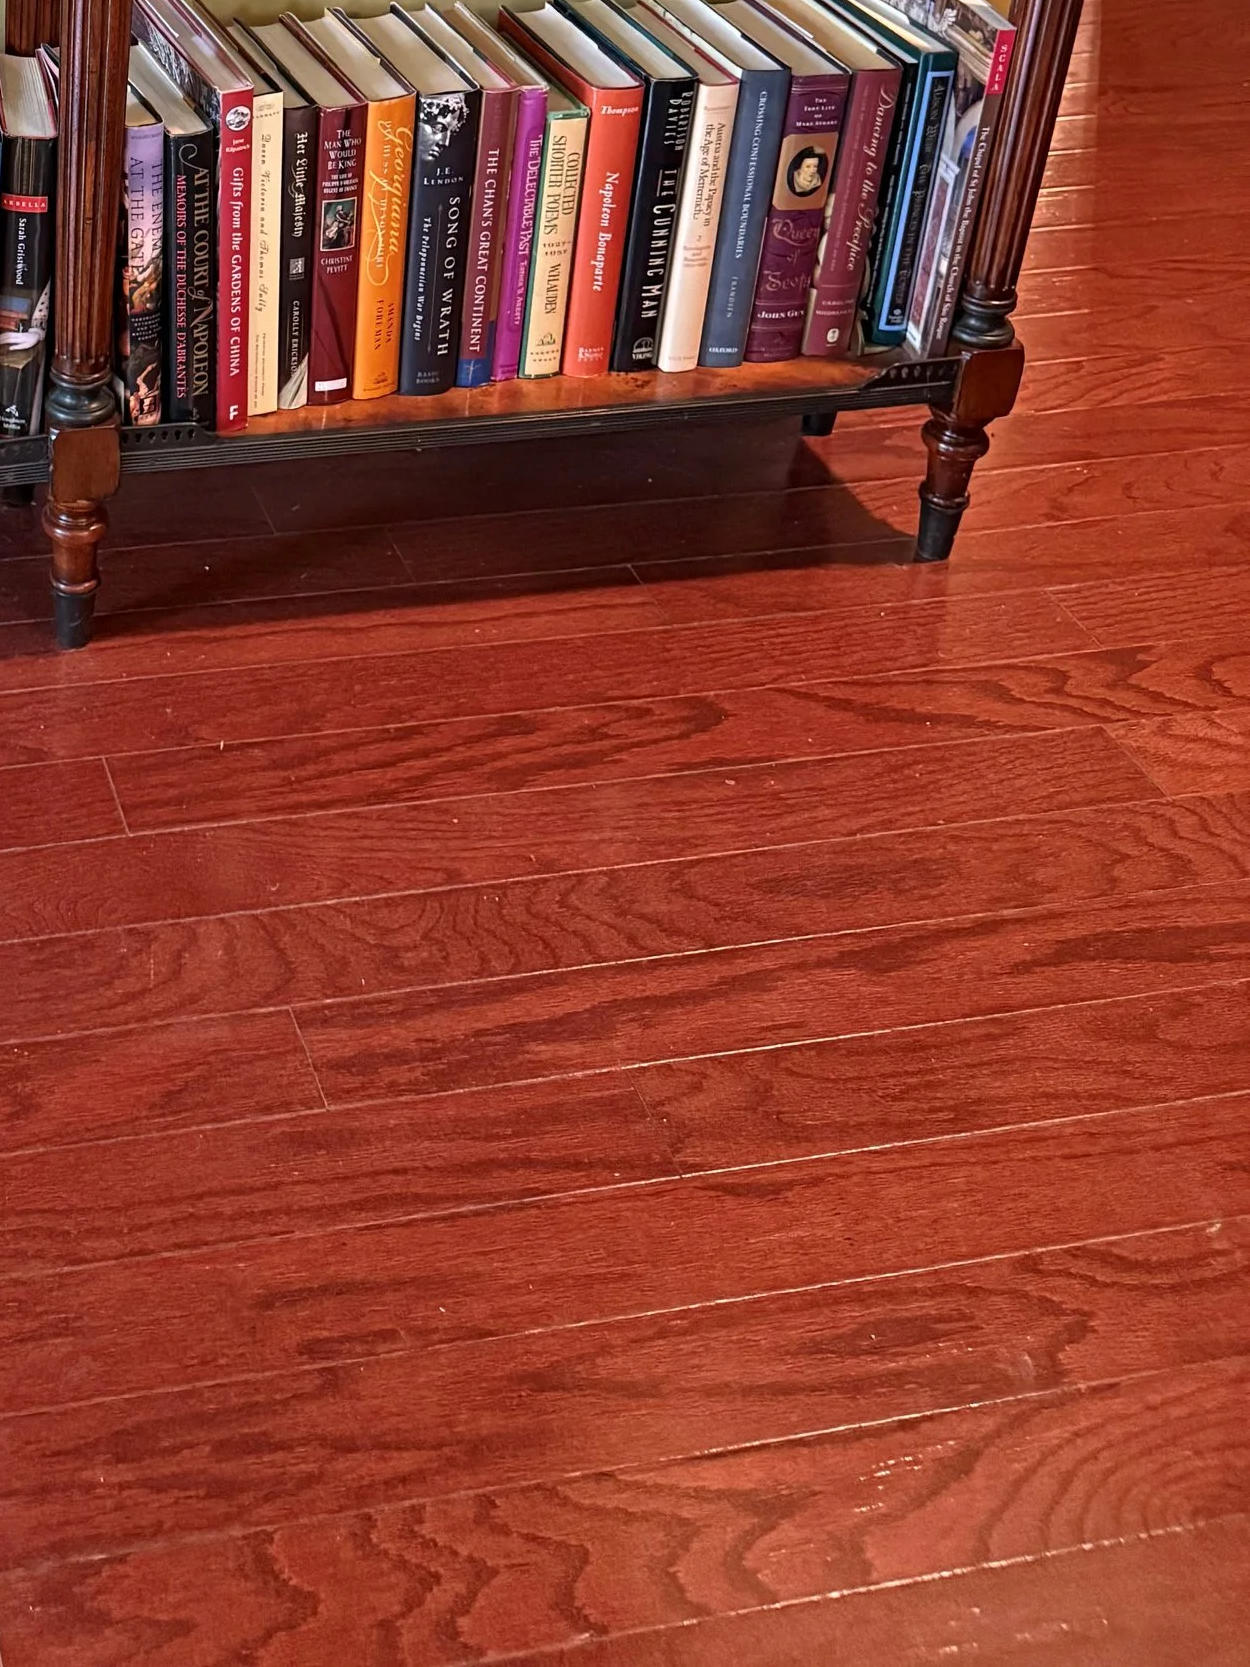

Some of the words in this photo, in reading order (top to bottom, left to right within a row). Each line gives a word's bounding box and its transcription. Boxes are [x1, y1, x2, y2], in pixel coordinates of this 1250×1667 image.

[991, 44, 1008, 91] SCALA
[601, 106, 639, 117] Thompson
[663, 99, 682, 145] DAVIES
[674, 92, 694, 151] ROBERTSON
[754, 91, 768, 135] CROSSING
[863, 86, 895, 157] Dancing
[296, 132, 308, 155] Her
[324, 141, 342, 150] MAN
[343, 139, 362, 147] WHO
[336, 130, 351, 139] THE
[529, 134, 543, 157] THE
[705, 123, 714, 137] the
[715, 122, 726, 155] Austria
[329, 150, 357, 160] WOULD
[487, 148, 500, 174] THE
[548, 135, 567, 188] SHORTER
[700, 138, 711, 155] Age
[700, 155, 708, 167] of
[130, 157, 144, 179] AT
[152, 158, 163, 196] THE
[179, 144, 209, 185] AT
[291, 158, 308, 191] Little
[328, 162, 337, 170] BE
[338, 159, 357, 170] KING
[711, 170, 720, 184] the
[713, 155, 721, 170] and
[745, 137, 761, 200] CONFESSIONAL
[865, 162, 878, 175] to
[231, 167, 244, 197] Gifts
[386, 124, 413, 253] Georgiana
[424, 176, 464, 185] LENDON
[521, 157, 541, 228] DELECTABLE
[561, 152, 581, 215] COLLECTED
[661, 169, 677, 196] THE
[860, 179, 875, 202] the
[131, 190, 144, 221] THE
[176, 174, 187, 228] MEMOIRS
[194, 188, 210, 227] THE
[231, 201, 244, 229] from
[288, 183, 308, 238] Majesty
[481, 179, 497, 227] CHAN'S
[544, 193, 561, 235] POEMS
[599, 172, 620, 227] Napoleon
[704, 185, 718, 216] Papacy
[18, 218, 27, 240] Sarah
[423, 217, 432, 233] The
[446, 196, 461, 249] SONG
[702, 216, 710, 227] in
[735, 203, 751, 258] BOUNDARIES
[771, 218, 821, 246] Queen
[130, 228, 145, 273] GATE
[176, 231, 187, 245] OF
[231, 233, 244, 251] the
[476, 231, 491, 271] GREAT
[518, 227, 533, 254] PAST
[647, 204, 676, 276] CUNNING
[846, 207, 874, 271] Precipice
[14, 242, 26, 285] Gristwood
[176, 247, 187, 270] THE
[193, 230, 210, 286] COURT
[321, 255, 353, 265] CHRISTINE
[326, 264, 348, 274] PEVITT
[443, 257, 456, 279] OF
[591, 231, 612, 292] Bonaparte
[187, 286, 204, 301] of
[230, 254, 243, 313] GARDENS
[176, 273, 187, 328] DUCHESSE
[417, 295, 425, 312] War
[469, 276, 487, 352] CONTINENT
[641, 284, 663, 318] MAN
[757, 310, 785, 319] JOHN
[787, 309, 805, 318] GUY
[230, 318, 241, 332] OF
[413, 315, 424, 341] Begins
[437, 288, 453, 356] WRATH
[189, 299, 214, 397] NAPOLEON
[229, 336, 241, 377] CHINA
